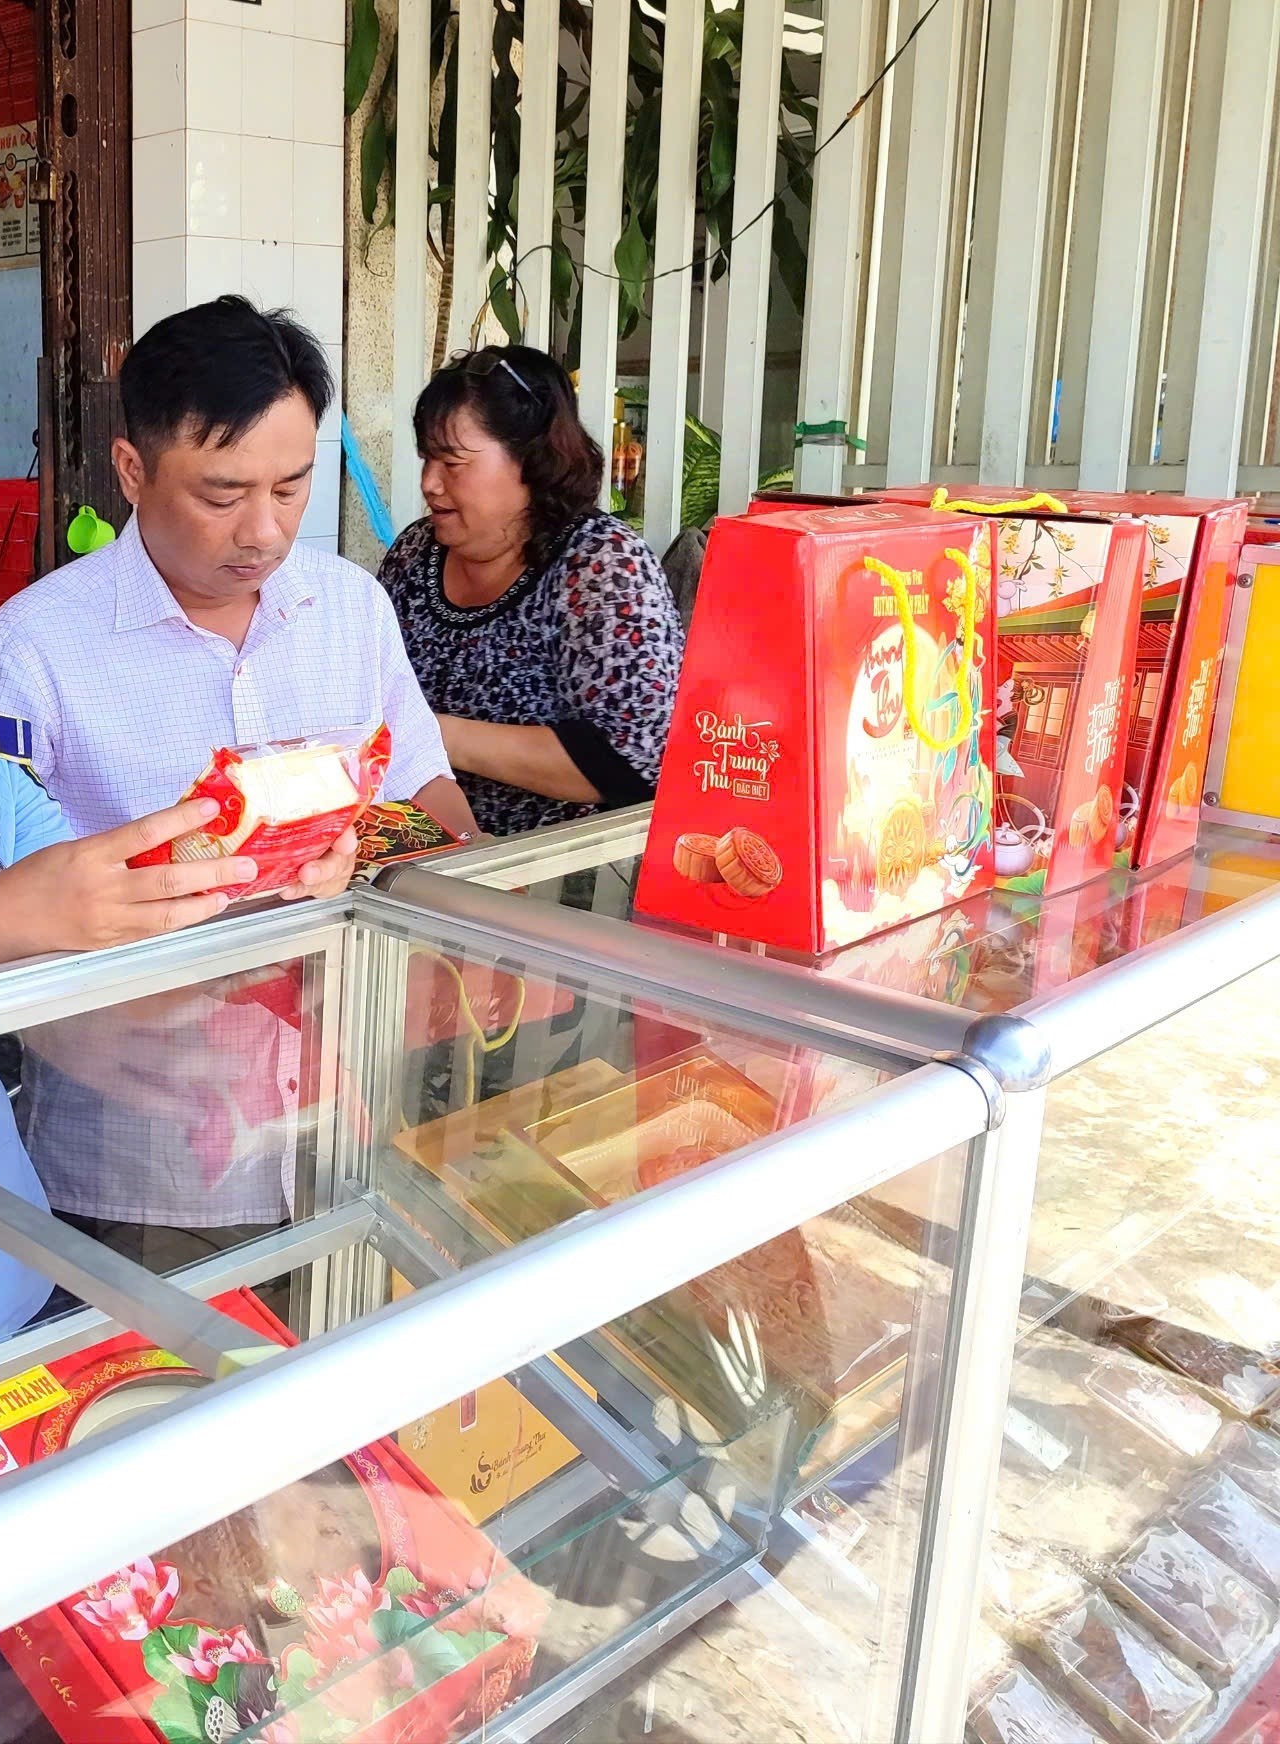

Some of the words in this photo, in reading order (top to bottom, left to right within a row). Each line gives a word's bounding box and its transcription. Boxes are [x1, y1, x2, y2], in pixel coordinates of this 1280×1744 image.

[695, 710, 773, 750] Bánh
[693, 760, 733, 792] Thu
[712, 741, 771, 782] Trung
[0, 1376, 58, 1412] THÀNH
